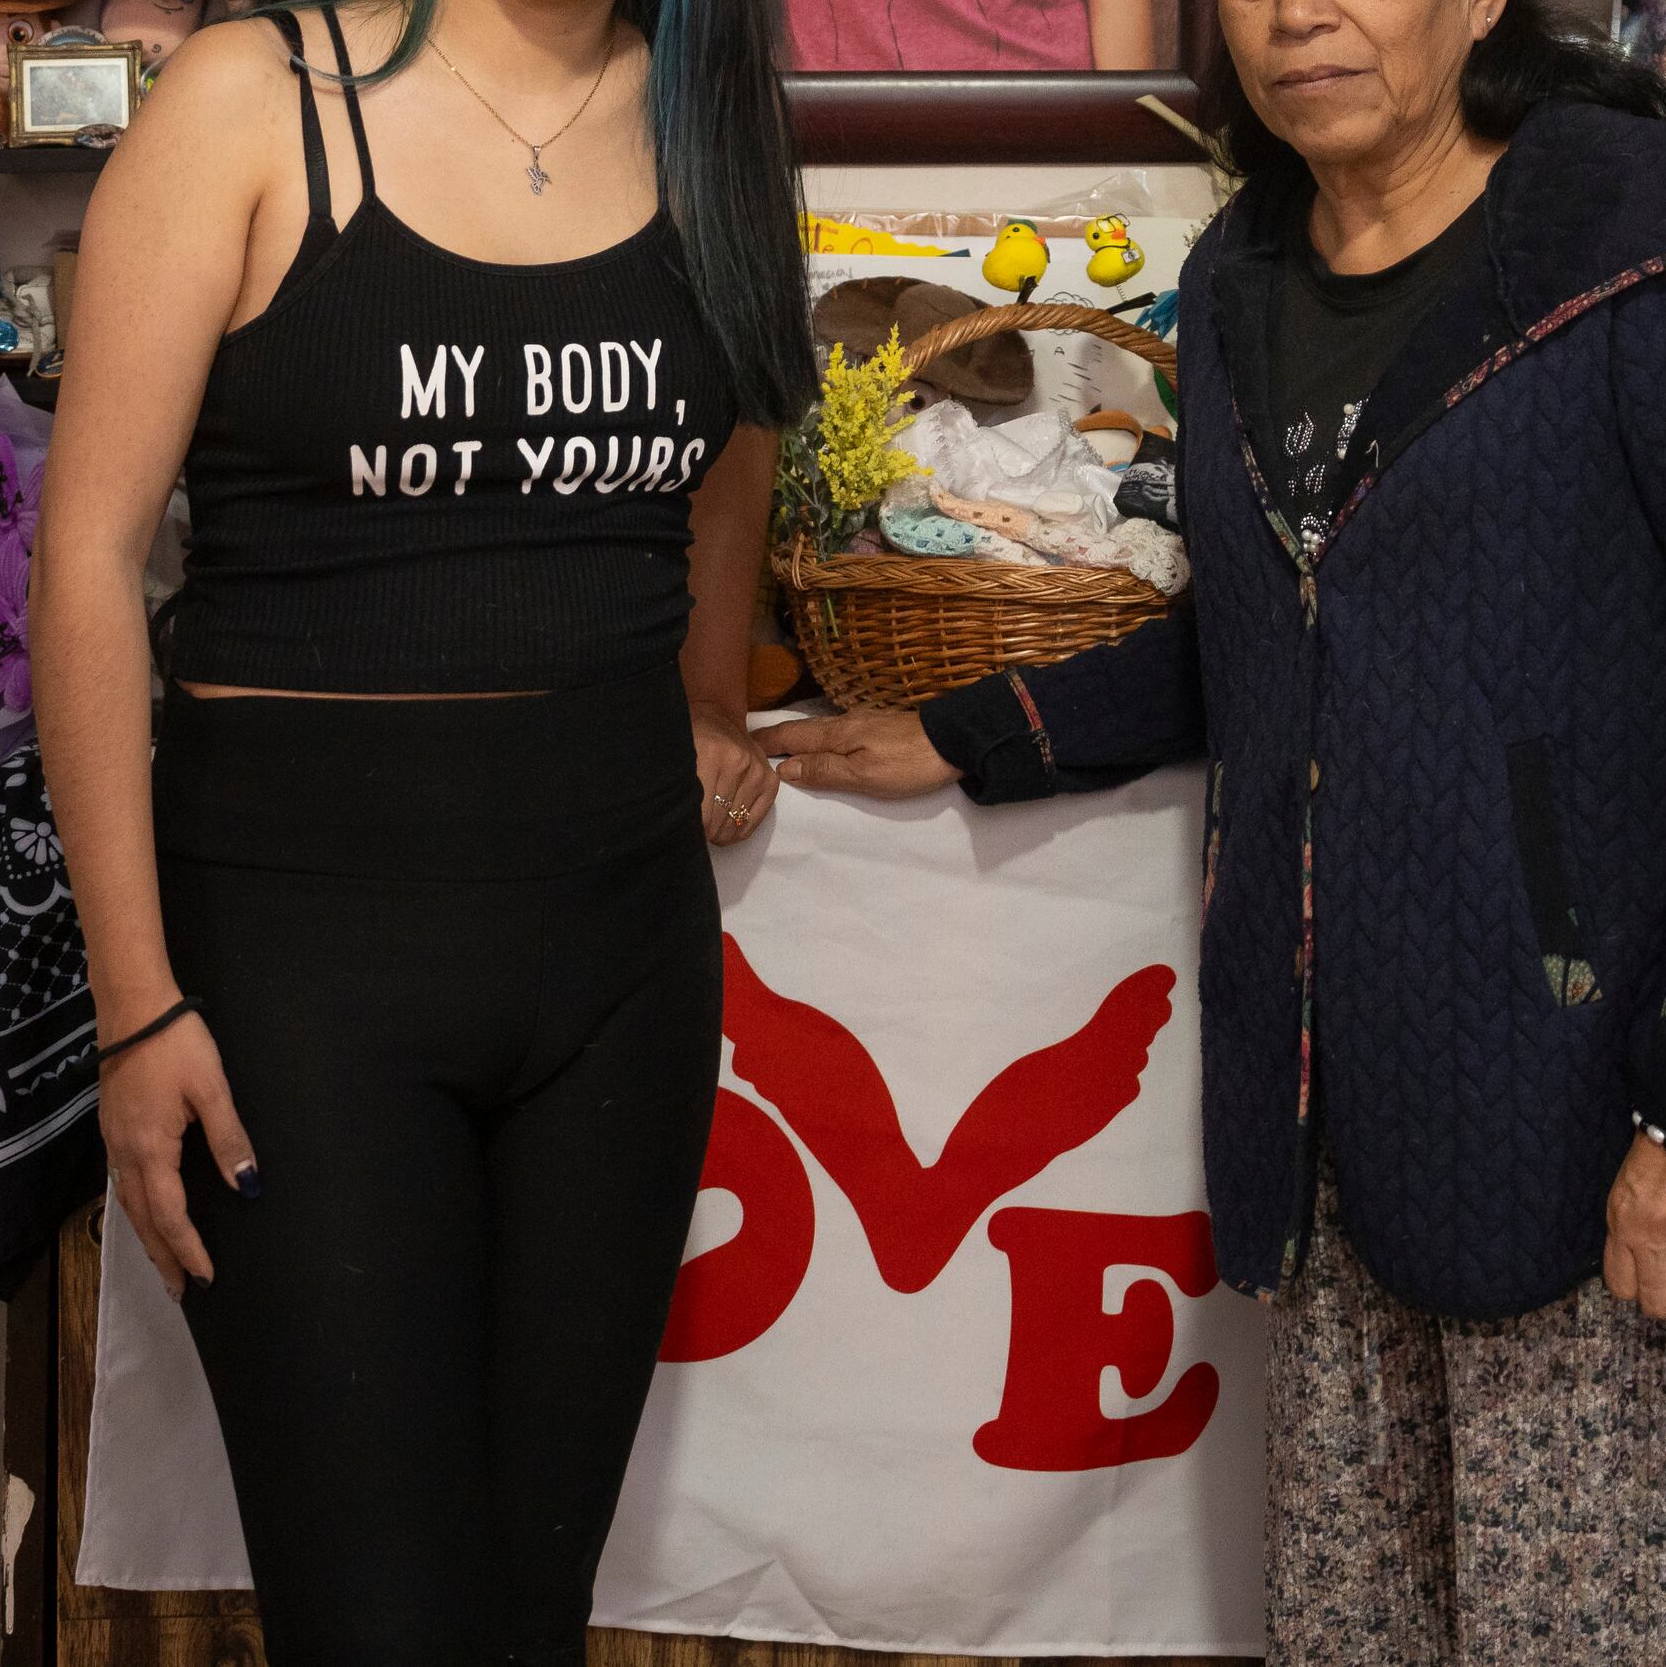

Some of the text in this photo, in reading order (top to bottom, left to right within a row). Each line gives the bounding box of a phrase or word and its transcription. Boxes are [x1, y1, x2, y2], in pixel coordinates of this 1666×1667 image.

[400, 338, 686, 426] MY BODY,
[349, 435, 705, 497] NOT YOURS
[656, 931, 1222, 1473] OVE
